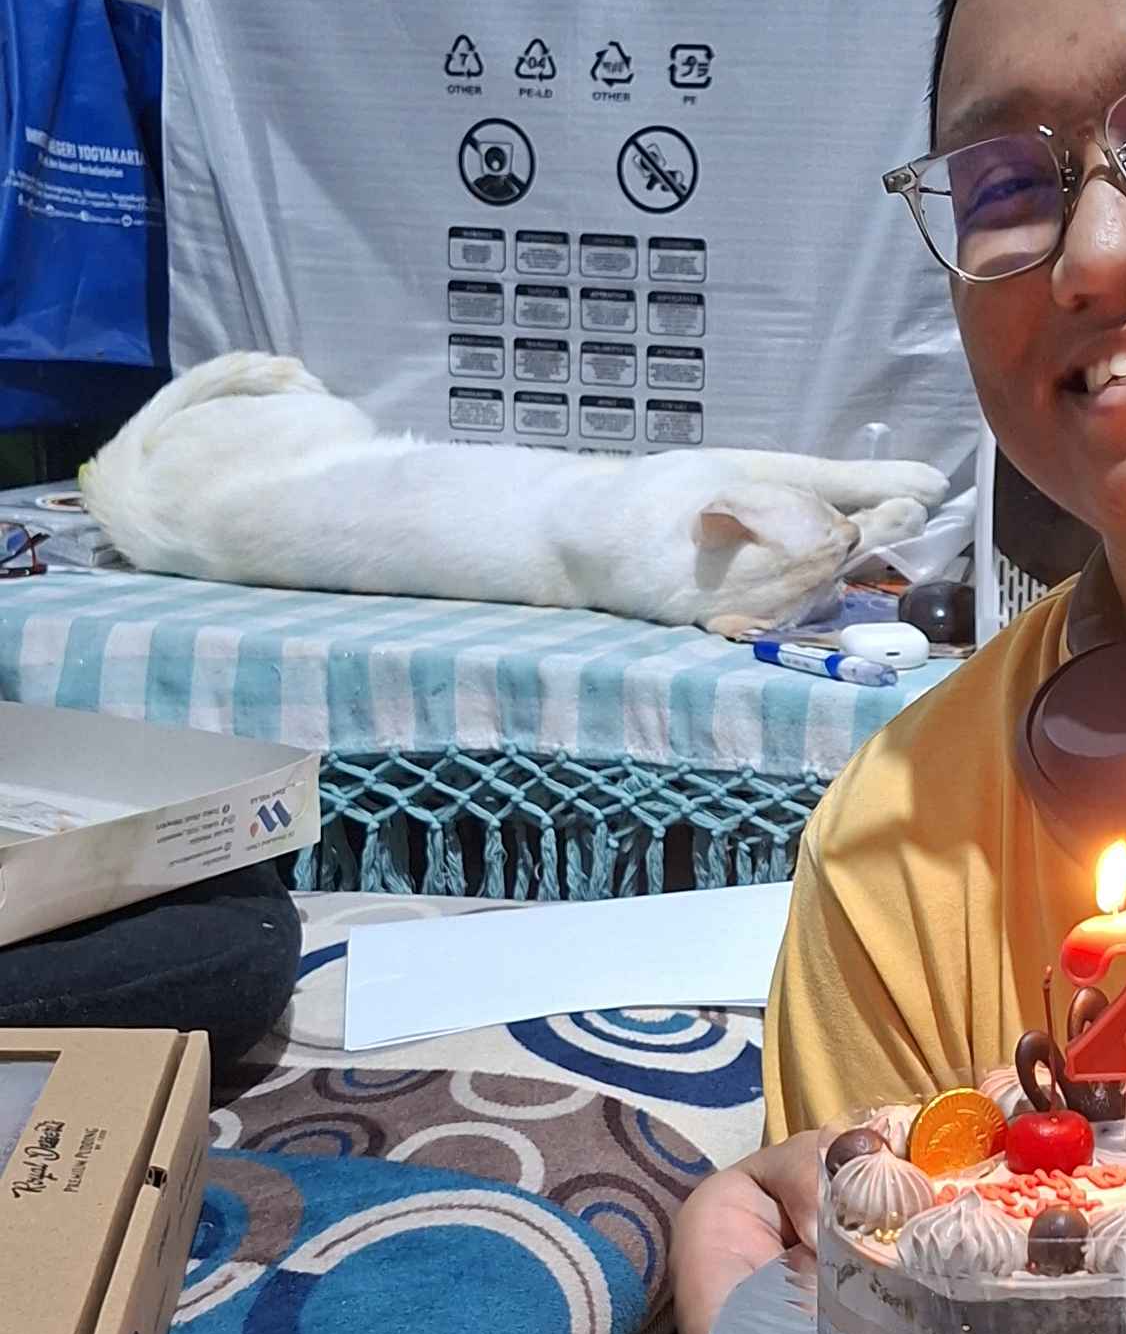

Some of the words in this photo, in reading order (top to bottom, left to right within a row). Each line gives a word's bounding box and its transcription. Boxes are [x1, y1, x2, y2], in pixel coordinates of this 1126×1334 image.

[459, 53, 469, 66] 7
[528, 56, 547, 69] 04
[447, 85, 482, 96] OTHER
[592, 91, 632, 102] OTHER
[11, 1160, 59, 1199] Royal
